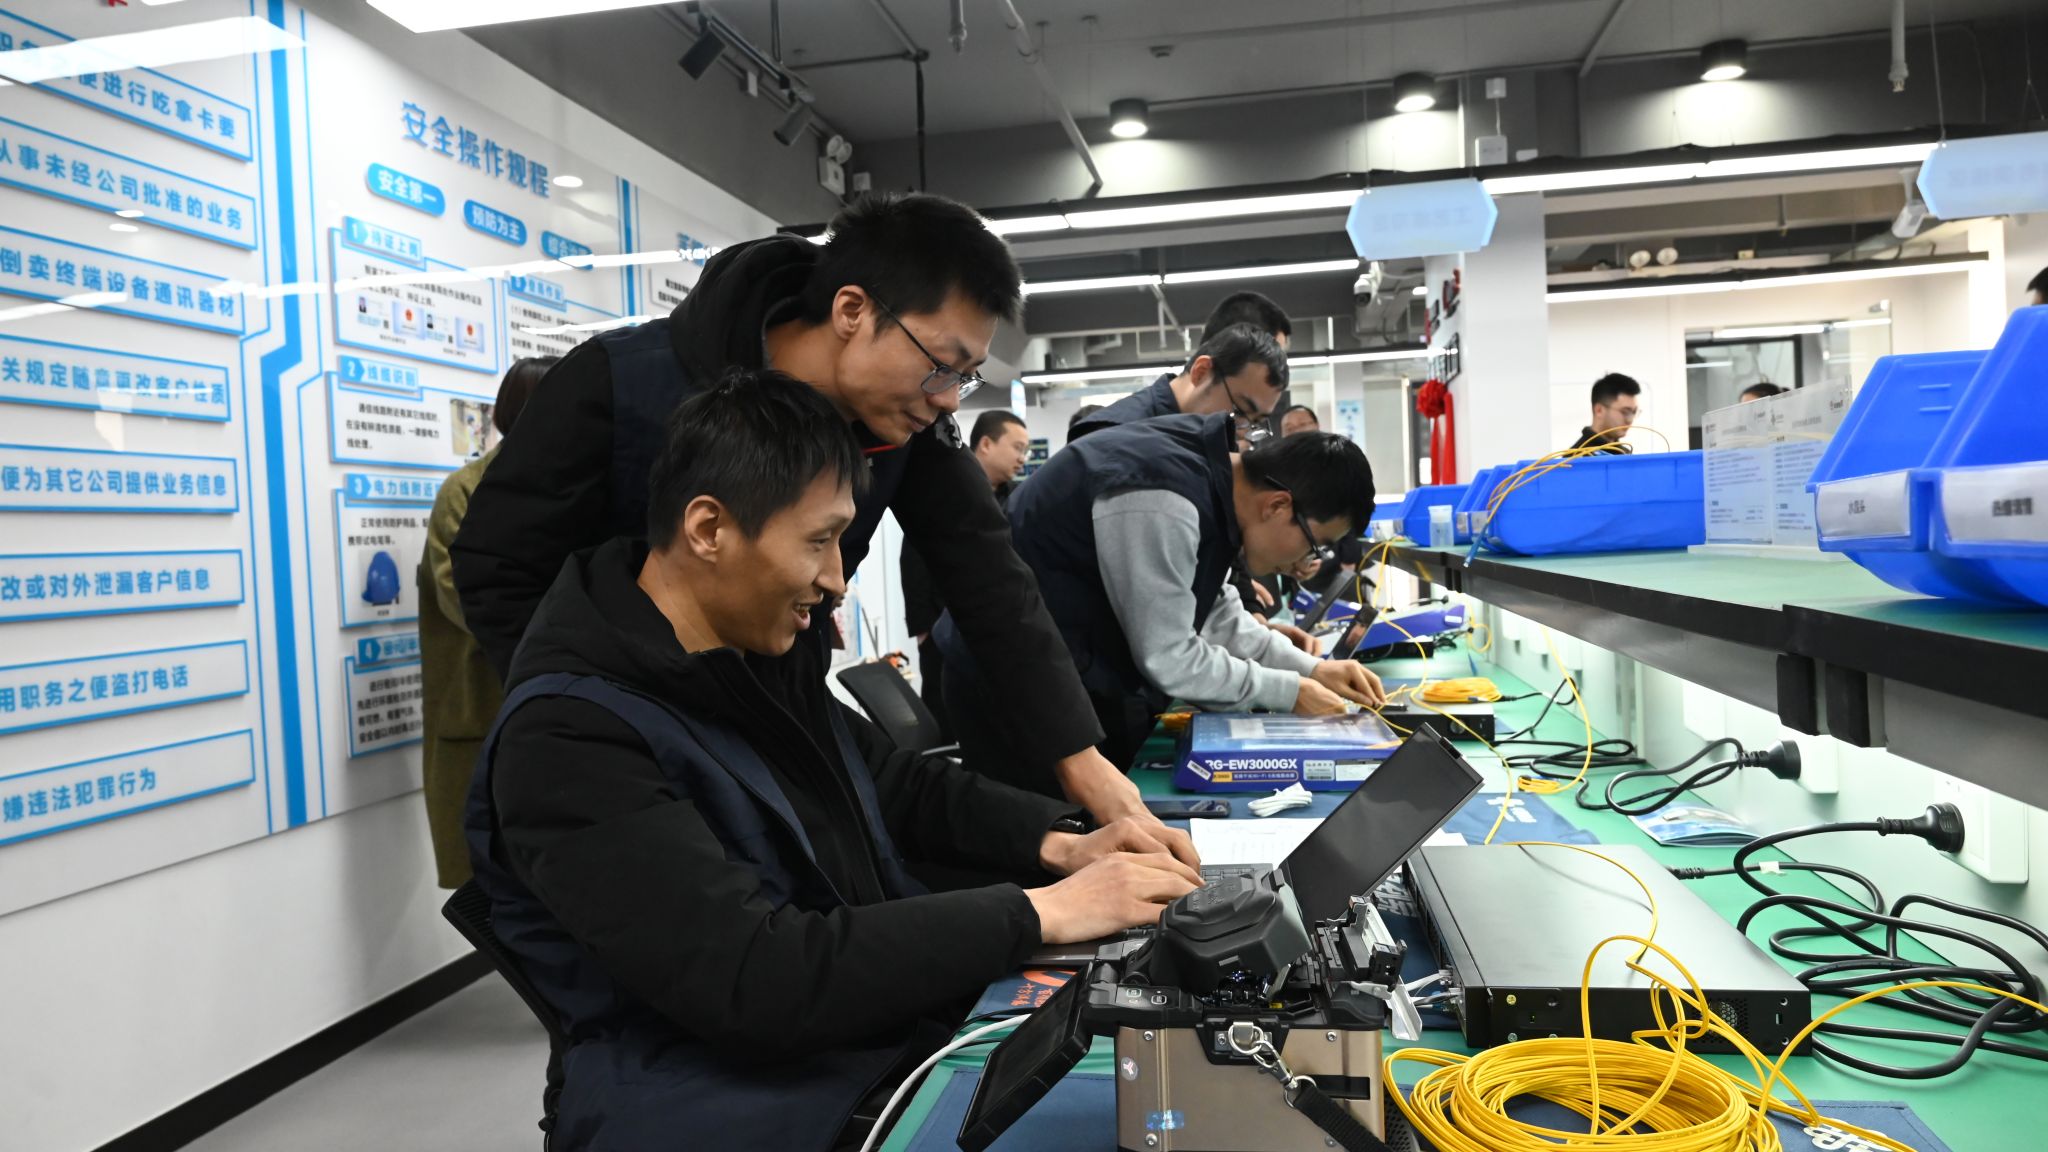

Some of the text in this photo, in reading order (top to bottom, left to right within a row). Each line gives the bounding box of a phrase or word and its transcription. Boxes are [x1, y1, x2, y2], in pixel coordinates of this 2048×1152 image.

[402, 101, 549, 198] 安全操作规程
[378, 169, 437, 204] 安全第一
[472, 206, 520, 241] 预防为主
[0, 247, 234, 317] 倒卖终端设备通讯器材
[2, 357, 225, 405] 关规定随意更改客户性质
[1, 466, 226, 496] 便为其它公司提供业务信息
[374, 479, 442, 497] 电力线附近
[1, 569, 210, 600] 改或对外泄漏客户信息
[0, 665, 188, 713] 用职务之便盗打电话
[3, 768, 156, 823] 嫌违法犯罪行为
